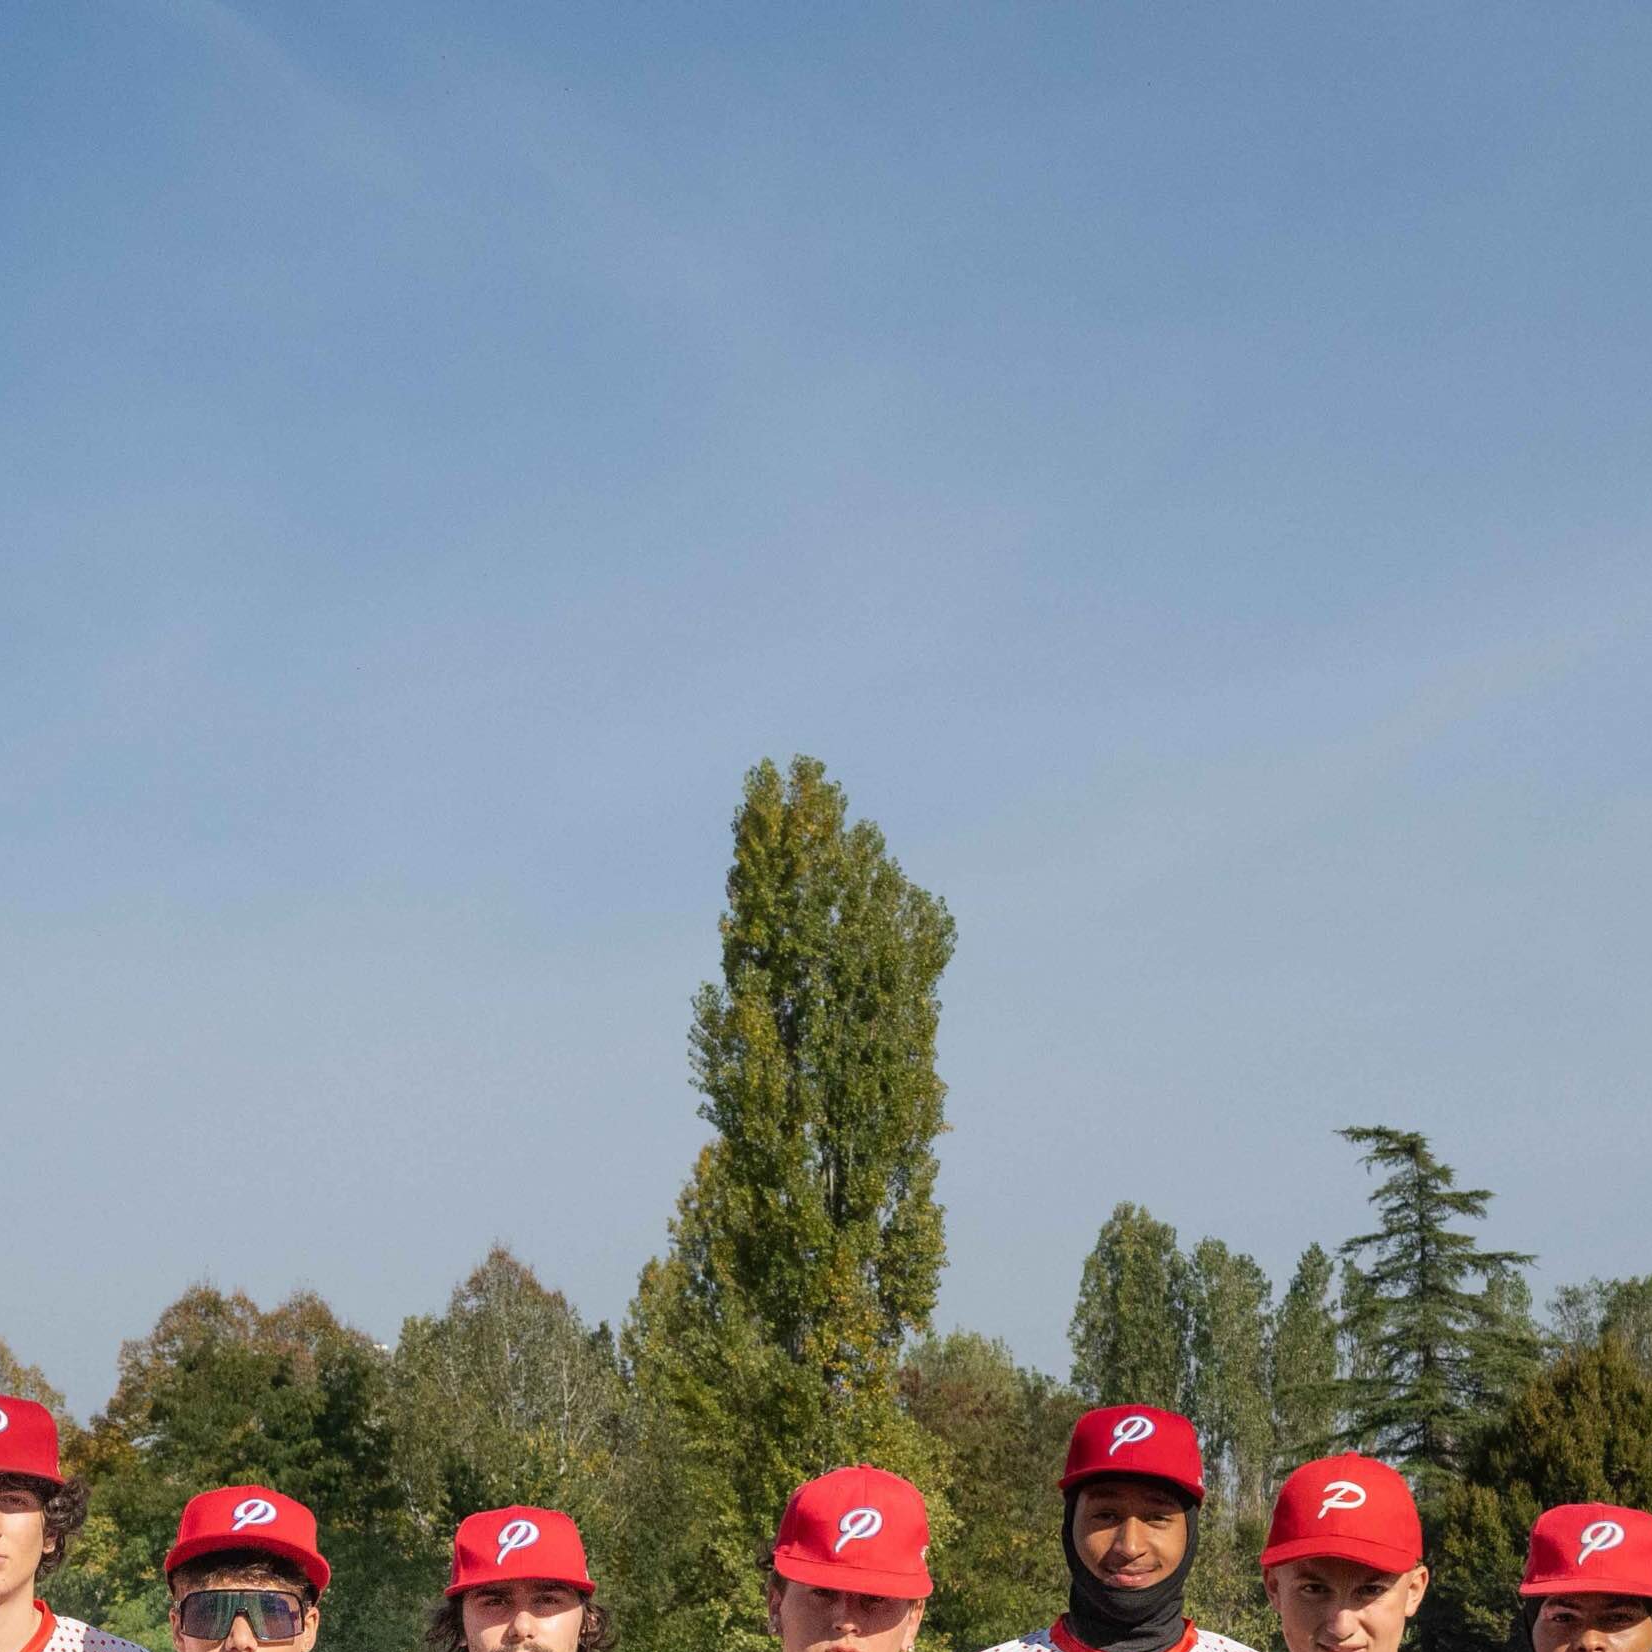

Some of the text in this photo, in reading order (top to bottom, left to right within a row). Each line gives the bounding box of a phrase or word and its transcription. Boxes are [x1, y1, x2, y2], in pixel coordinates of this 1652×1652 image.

[1109, 1416, 1155, 1457] P
[232, 1498, 277, 1531] P
[1317, 1480, 1367, 1520] P
[496, 1519, 540, 1566] P
[835, 1507, 884, 1553] P
[1578, 1520, 1625, 1565] P
